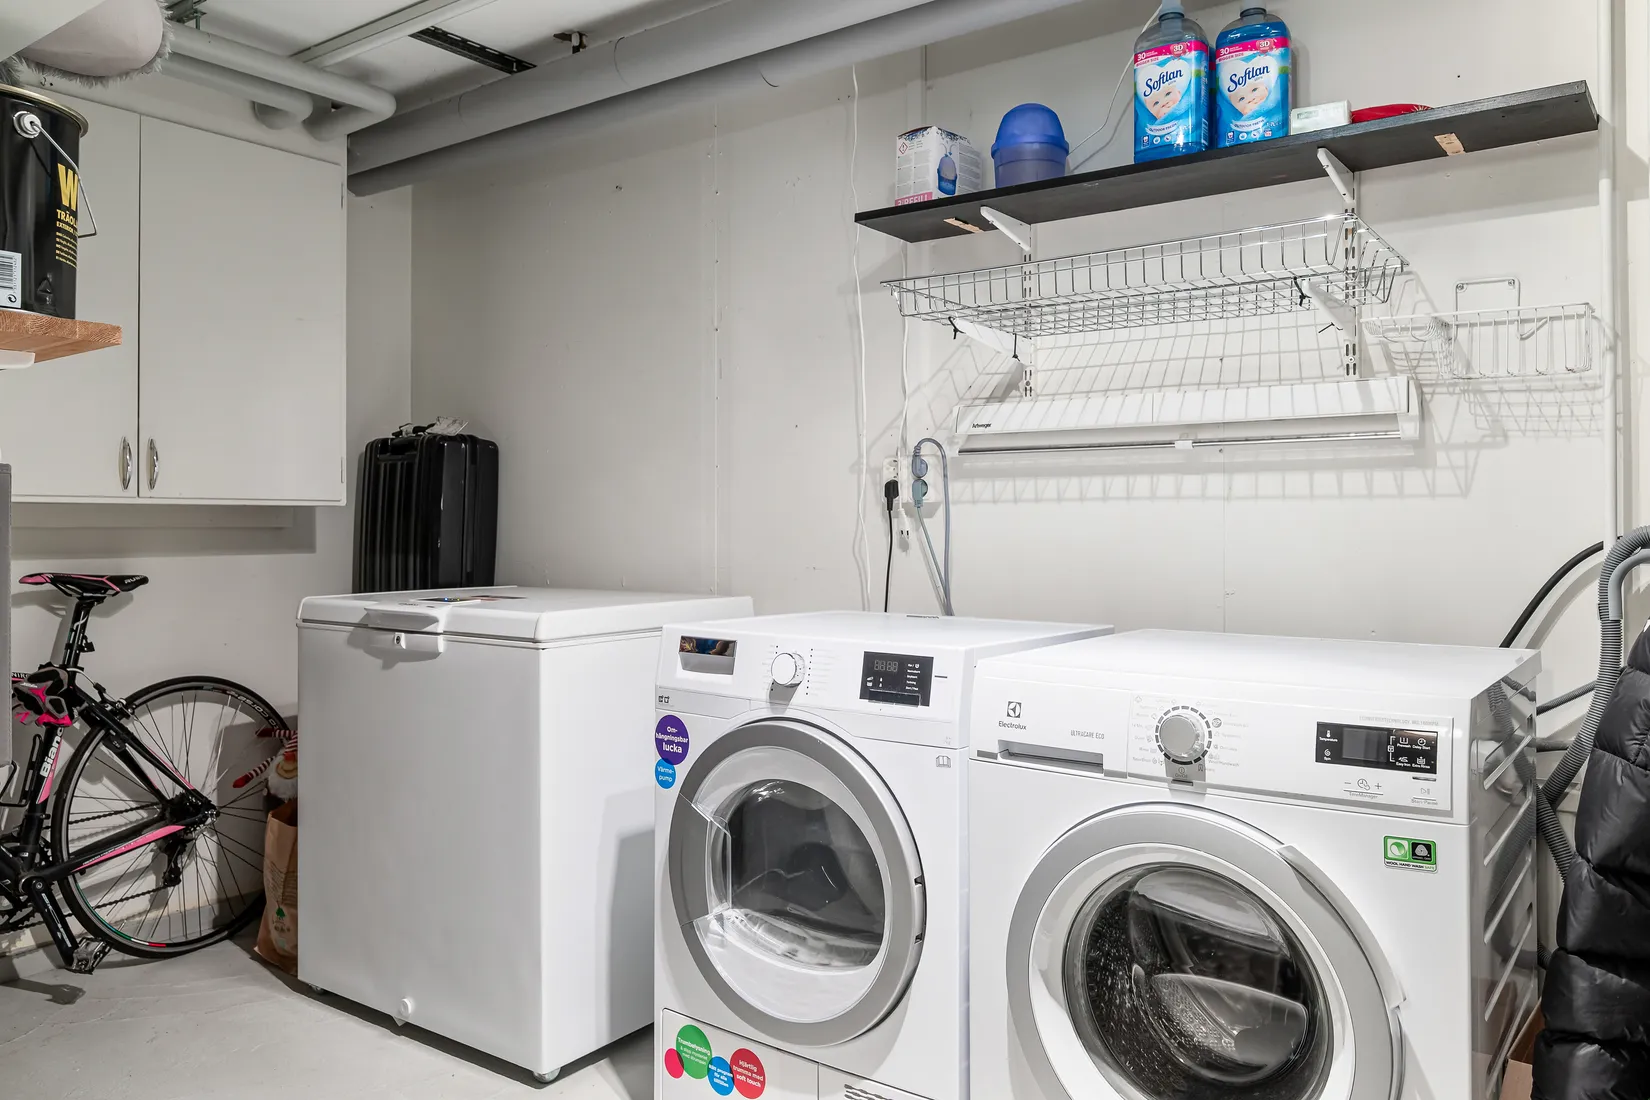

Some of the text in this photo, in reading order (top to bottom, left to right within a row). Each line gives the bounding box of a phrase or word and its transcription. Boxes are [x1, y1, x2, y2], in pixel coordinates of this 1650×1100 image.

[1173, 43, 1184, 52] 3D
[1259, 40, 1270, 48] 3D
[1219, 47, 1230, 56] 30
[1137, 52, 1146, 61] 30
[1143, 68, 1184, 97] Softlan
[1227, 65, 1270, 93] Softlan
[997, 720, 1027, 731] Electrolux
[1095, 732, 1105, 740] ECO
[662, 742, 683, 753] lucka
[657, 765, 675, 774] Värme-
[658, 775, 673, 783] pump
[716, 1068, 734, 1078] program
[732, 1064, 764, 1082] trumma med
[736, 1074, 762, 1088] soft touch
